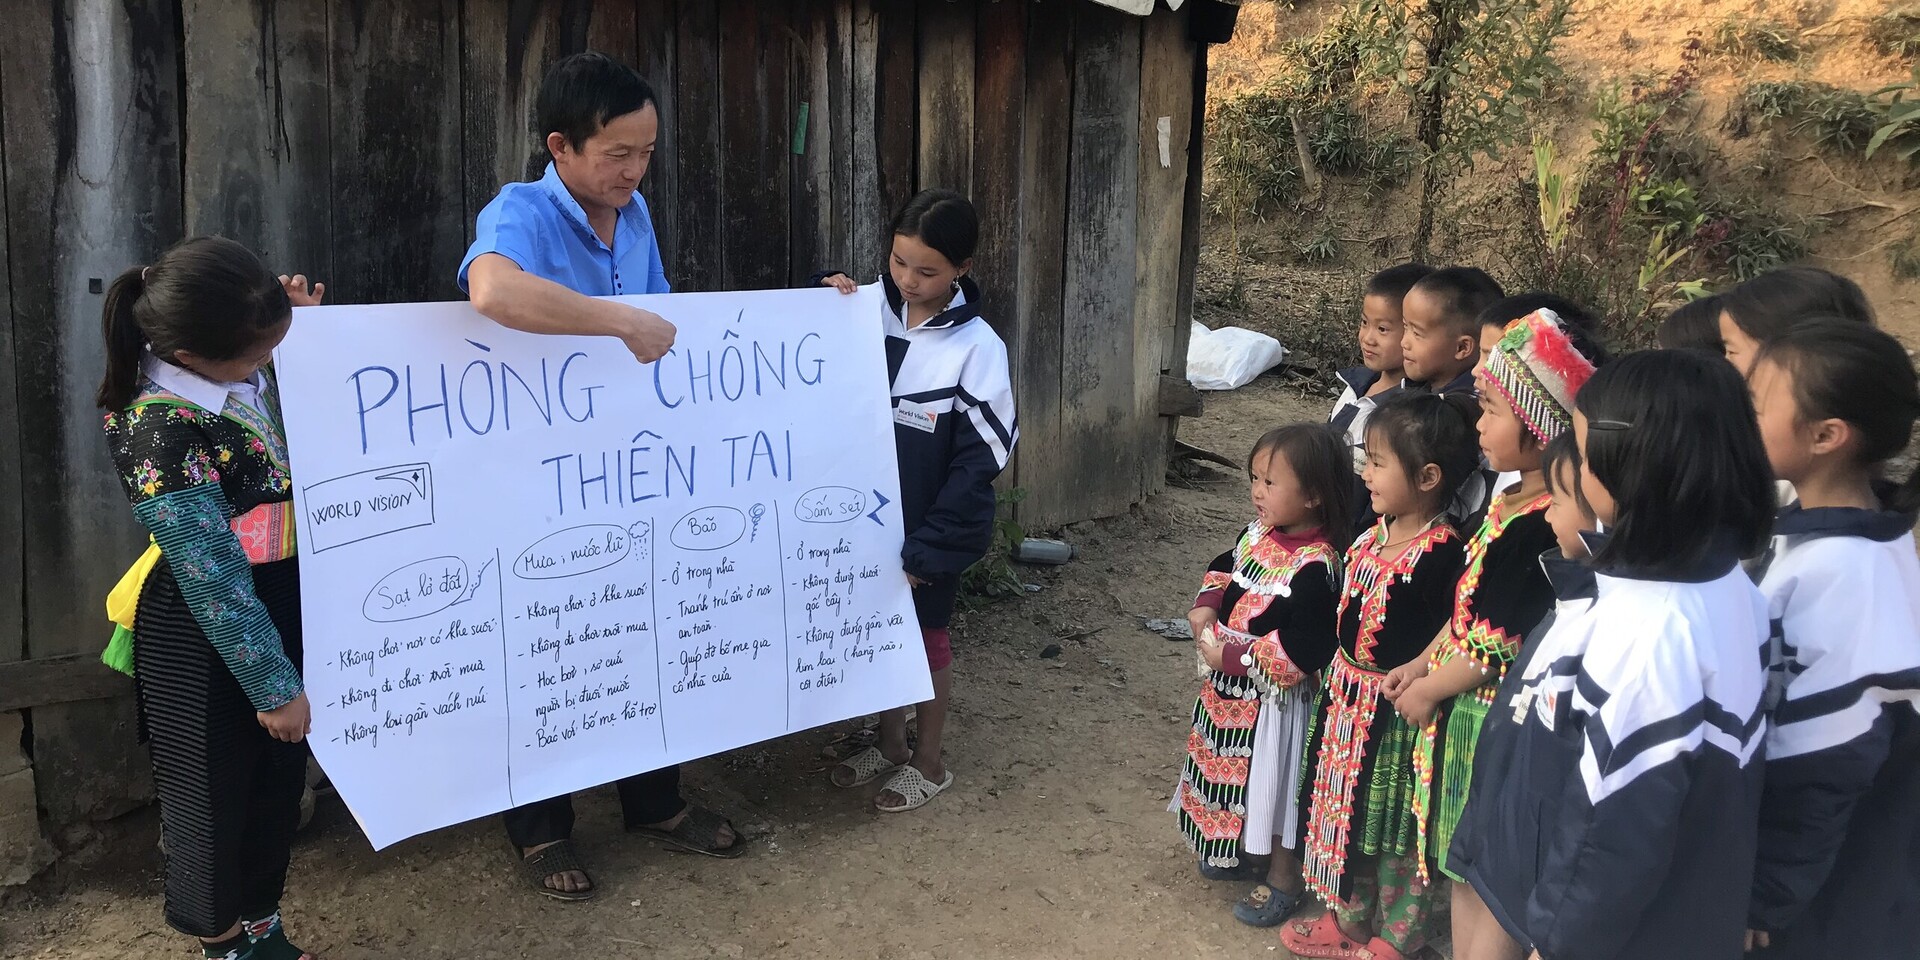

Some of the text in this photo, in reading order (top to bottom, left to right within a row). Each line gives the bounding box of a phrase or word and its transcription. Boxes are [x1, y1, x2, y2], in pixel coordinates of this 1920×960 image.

[346, 308, 825, 455] PHÒNG CHỐNG
[542, 430, 792, 515] THIÊN TAI
[311, 500, 361, 525] WORLD
[802, 494, 861, 519] Sấm sét
[687, 516, 717, 536] Bão
[525, 531, 623, 571] Mưa nước lũ
[809, 546, 830, 567] trong
[832, 538, 852, 555] nhà
[378, 568, 462, 609] Sạt lở đất
[687, 566, 712, 589] trong
[803, 573, 829, 597] Không
[527, 601, 560, 629] Không
[600, 584, 622, 603] khe
[678, 593, 709, 618] Tránh
[713, 589, 729, 609] trú
[806, 592, 841, 623] gốc cây
[805, 629, 834, 650] Không
[865, 611, 883, 641] gần
[340, 649, 375, 677] Không
[430, 628, 443, 645] có
[446, 618, 468, 640] khe
[530, 637, 560, 663] Không
[564, 630, 577, 645] đi
[719, 638, 732, 656] bố
[753, 639, 771, 661] gia
[341, 688, 377, 712] Không
[382, 678, 395, 693] đi
[538, 670, 556, 691] Học
[672, 676, 686, 694] cố
[566, 689, 577, 710] bị
[344, 723, 378, 748] Không
[405, 702, 428, 736] gần
[433, 691, 461, 715] vách
[466, 686, 488, 708] núi
[583, 711, 598, 730] bố
[600, 713, 616, 726] mẹ
[639, 702, 657, 720] trợ
